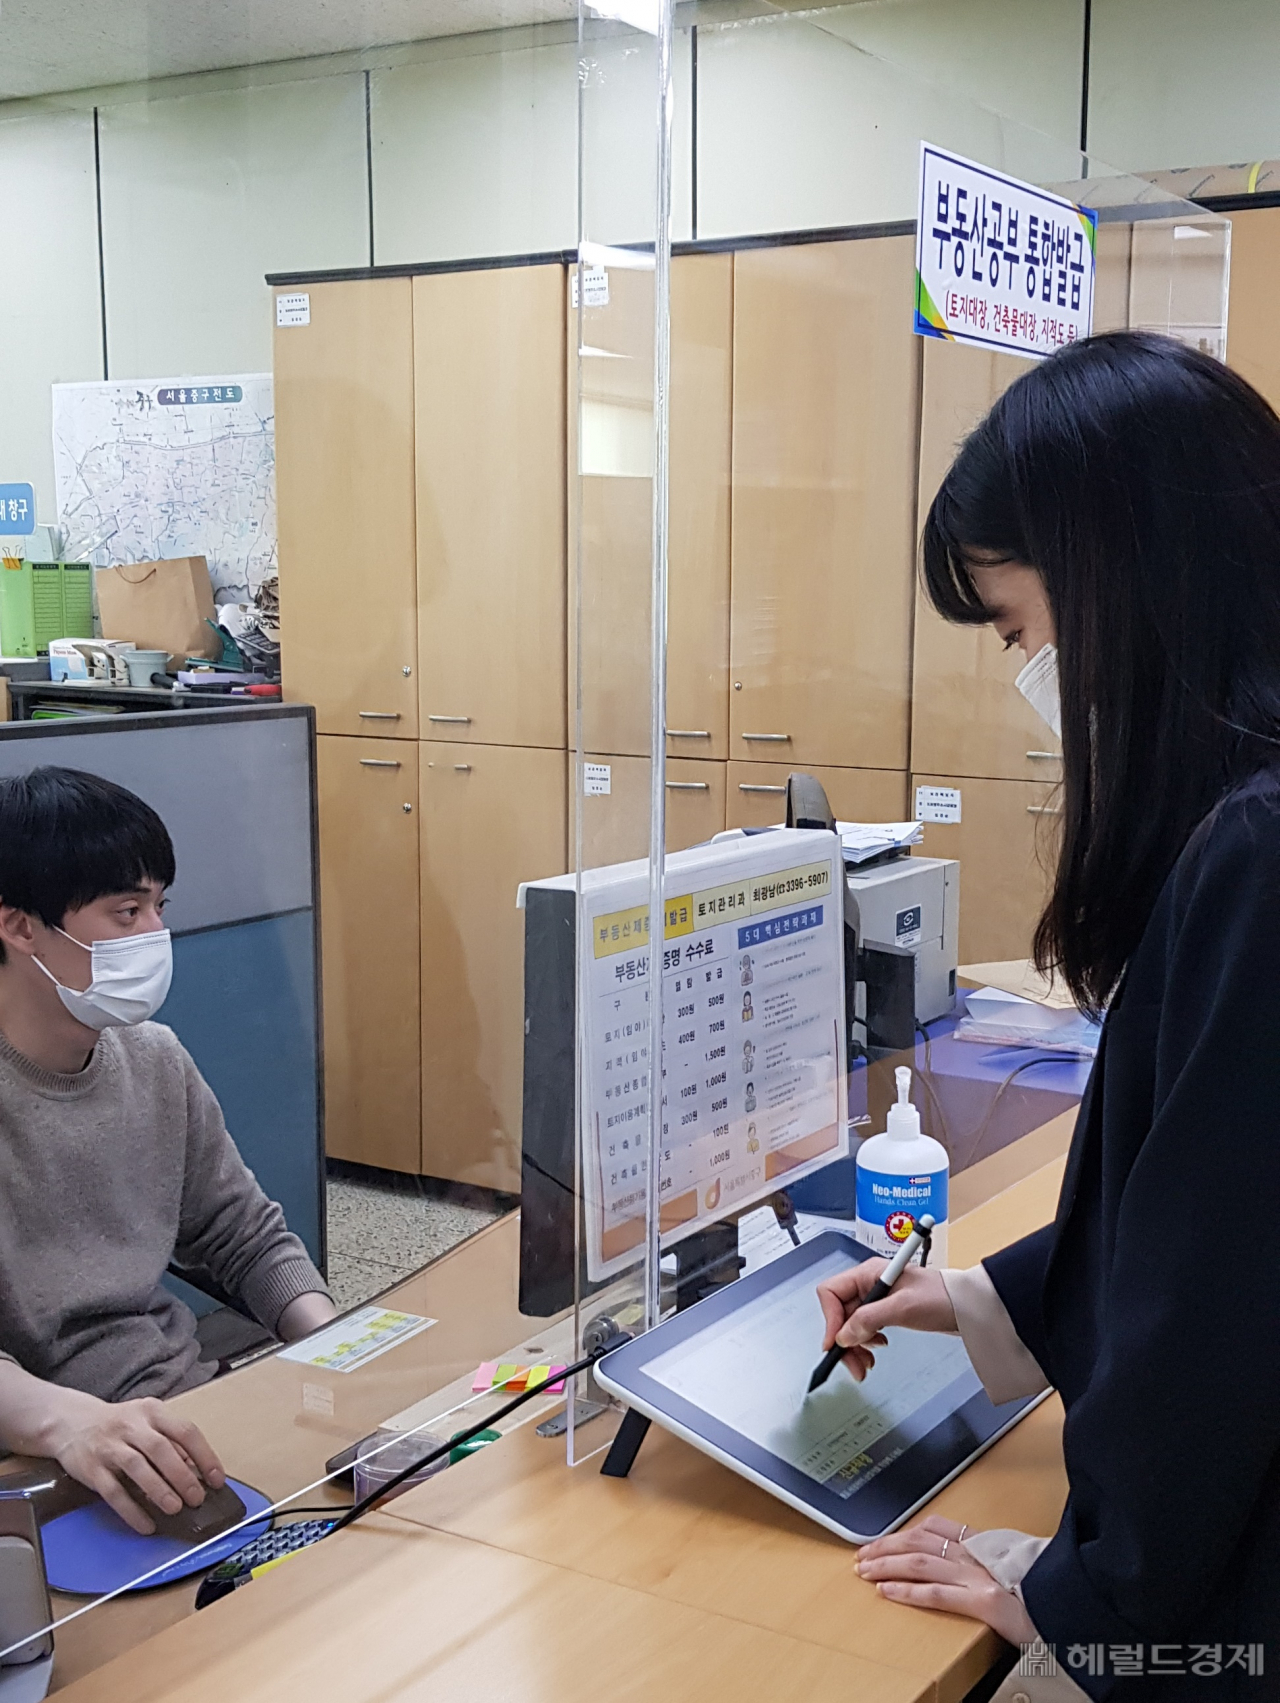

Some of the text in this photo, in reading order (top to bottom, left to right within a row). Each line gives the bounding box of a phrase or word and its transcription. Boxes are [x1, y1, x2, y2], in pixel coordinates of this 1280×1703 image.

[932, 179, 1085, 312] 부동산공부 통합발급
[945, 289, 989, 331] (토지대장,
[993, 304, 1039, 343] 건축물대장,
[1041, 317, 1064, 347] 지적도
[165, 387, 235, 402] 서울중구전도
[698, 890, 745, 916] 토지관리과
[685, 938, 714, 962] 수수료
[708, 993, 724, 1007] 500원
[709, 1020, 725, 1033] 700원
[872, 1183, 931, 1198] Neo-Medical
[875, 1195, 929, 1206] Hands Clean Gel
